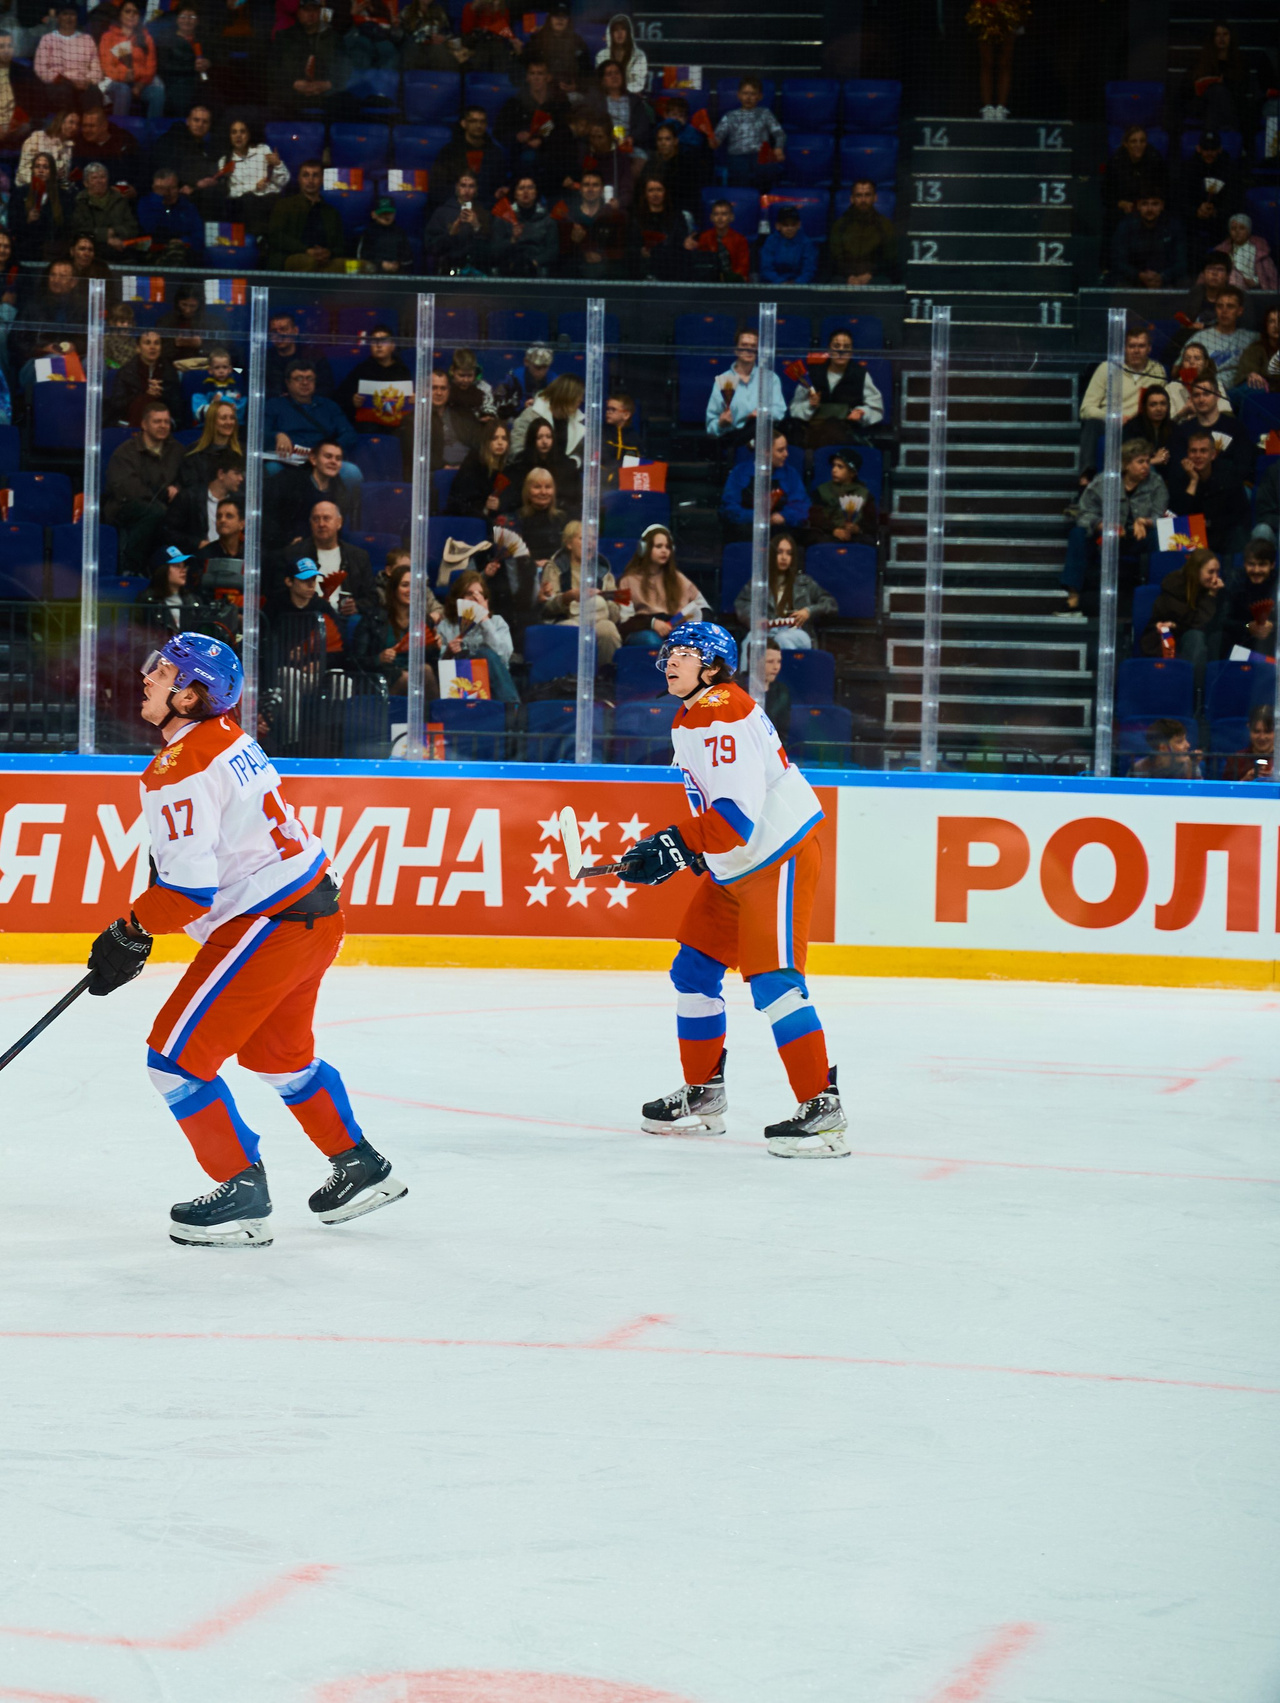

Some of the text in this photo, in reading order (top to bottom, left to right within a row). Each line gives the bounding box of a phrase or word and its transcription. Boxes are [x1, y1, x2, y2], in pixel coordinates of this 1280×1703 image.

[637, 21, 663, 40] 16
[922, 127, 949, 148] 14
[1037, 127, 1063, 149] 14
[915, 181, 943, 202] 13
[1038, 182, 1067, 203] 13
[911, 240, 939, 262] 12
[1037, 241, 1064, 264] 12
[910, 298, 933, 319] 11
[1039, 302, 1062, 324] 11
[193, 667, 216, 681] CCM
[704, 734, 736, 767] 79
[161, 798, 194, 842] 17
[935, 815, 1280, 934] РОЛ
